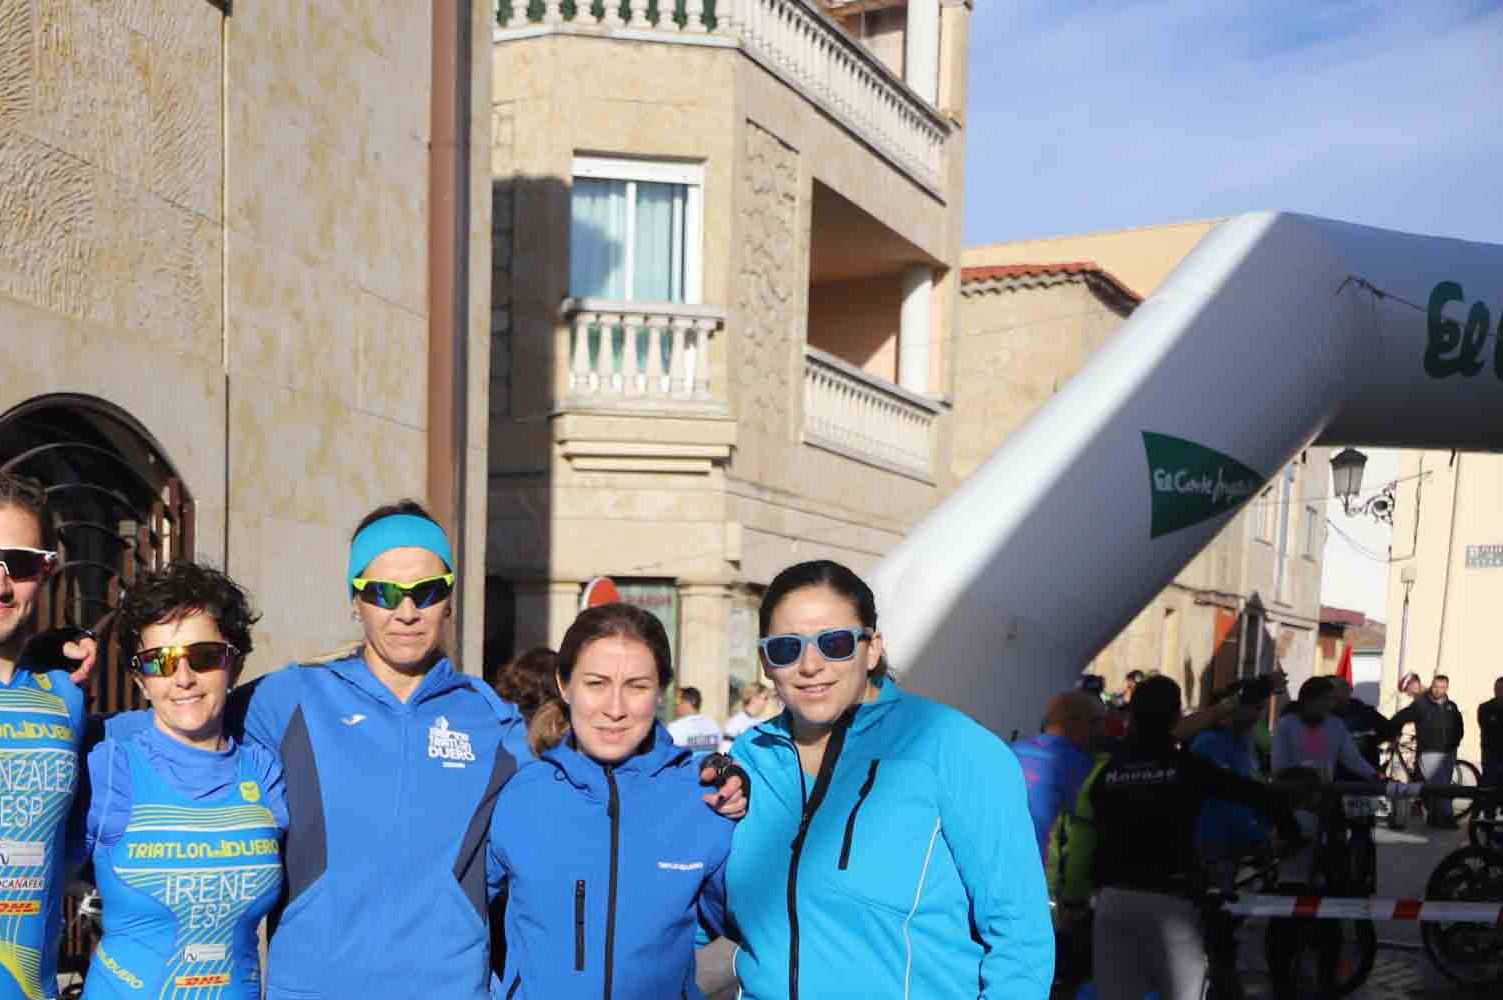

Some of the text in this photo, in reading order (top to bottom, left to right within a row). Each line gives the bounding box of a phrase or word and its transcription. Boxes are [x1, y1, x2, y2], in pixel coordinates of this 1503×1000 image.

[1424, 281, 1489, 378] El
[0, 795, 44, 828] ESP
[166, 872, 258, 905] IRENE
[189, 904, 231, 929] ESP
